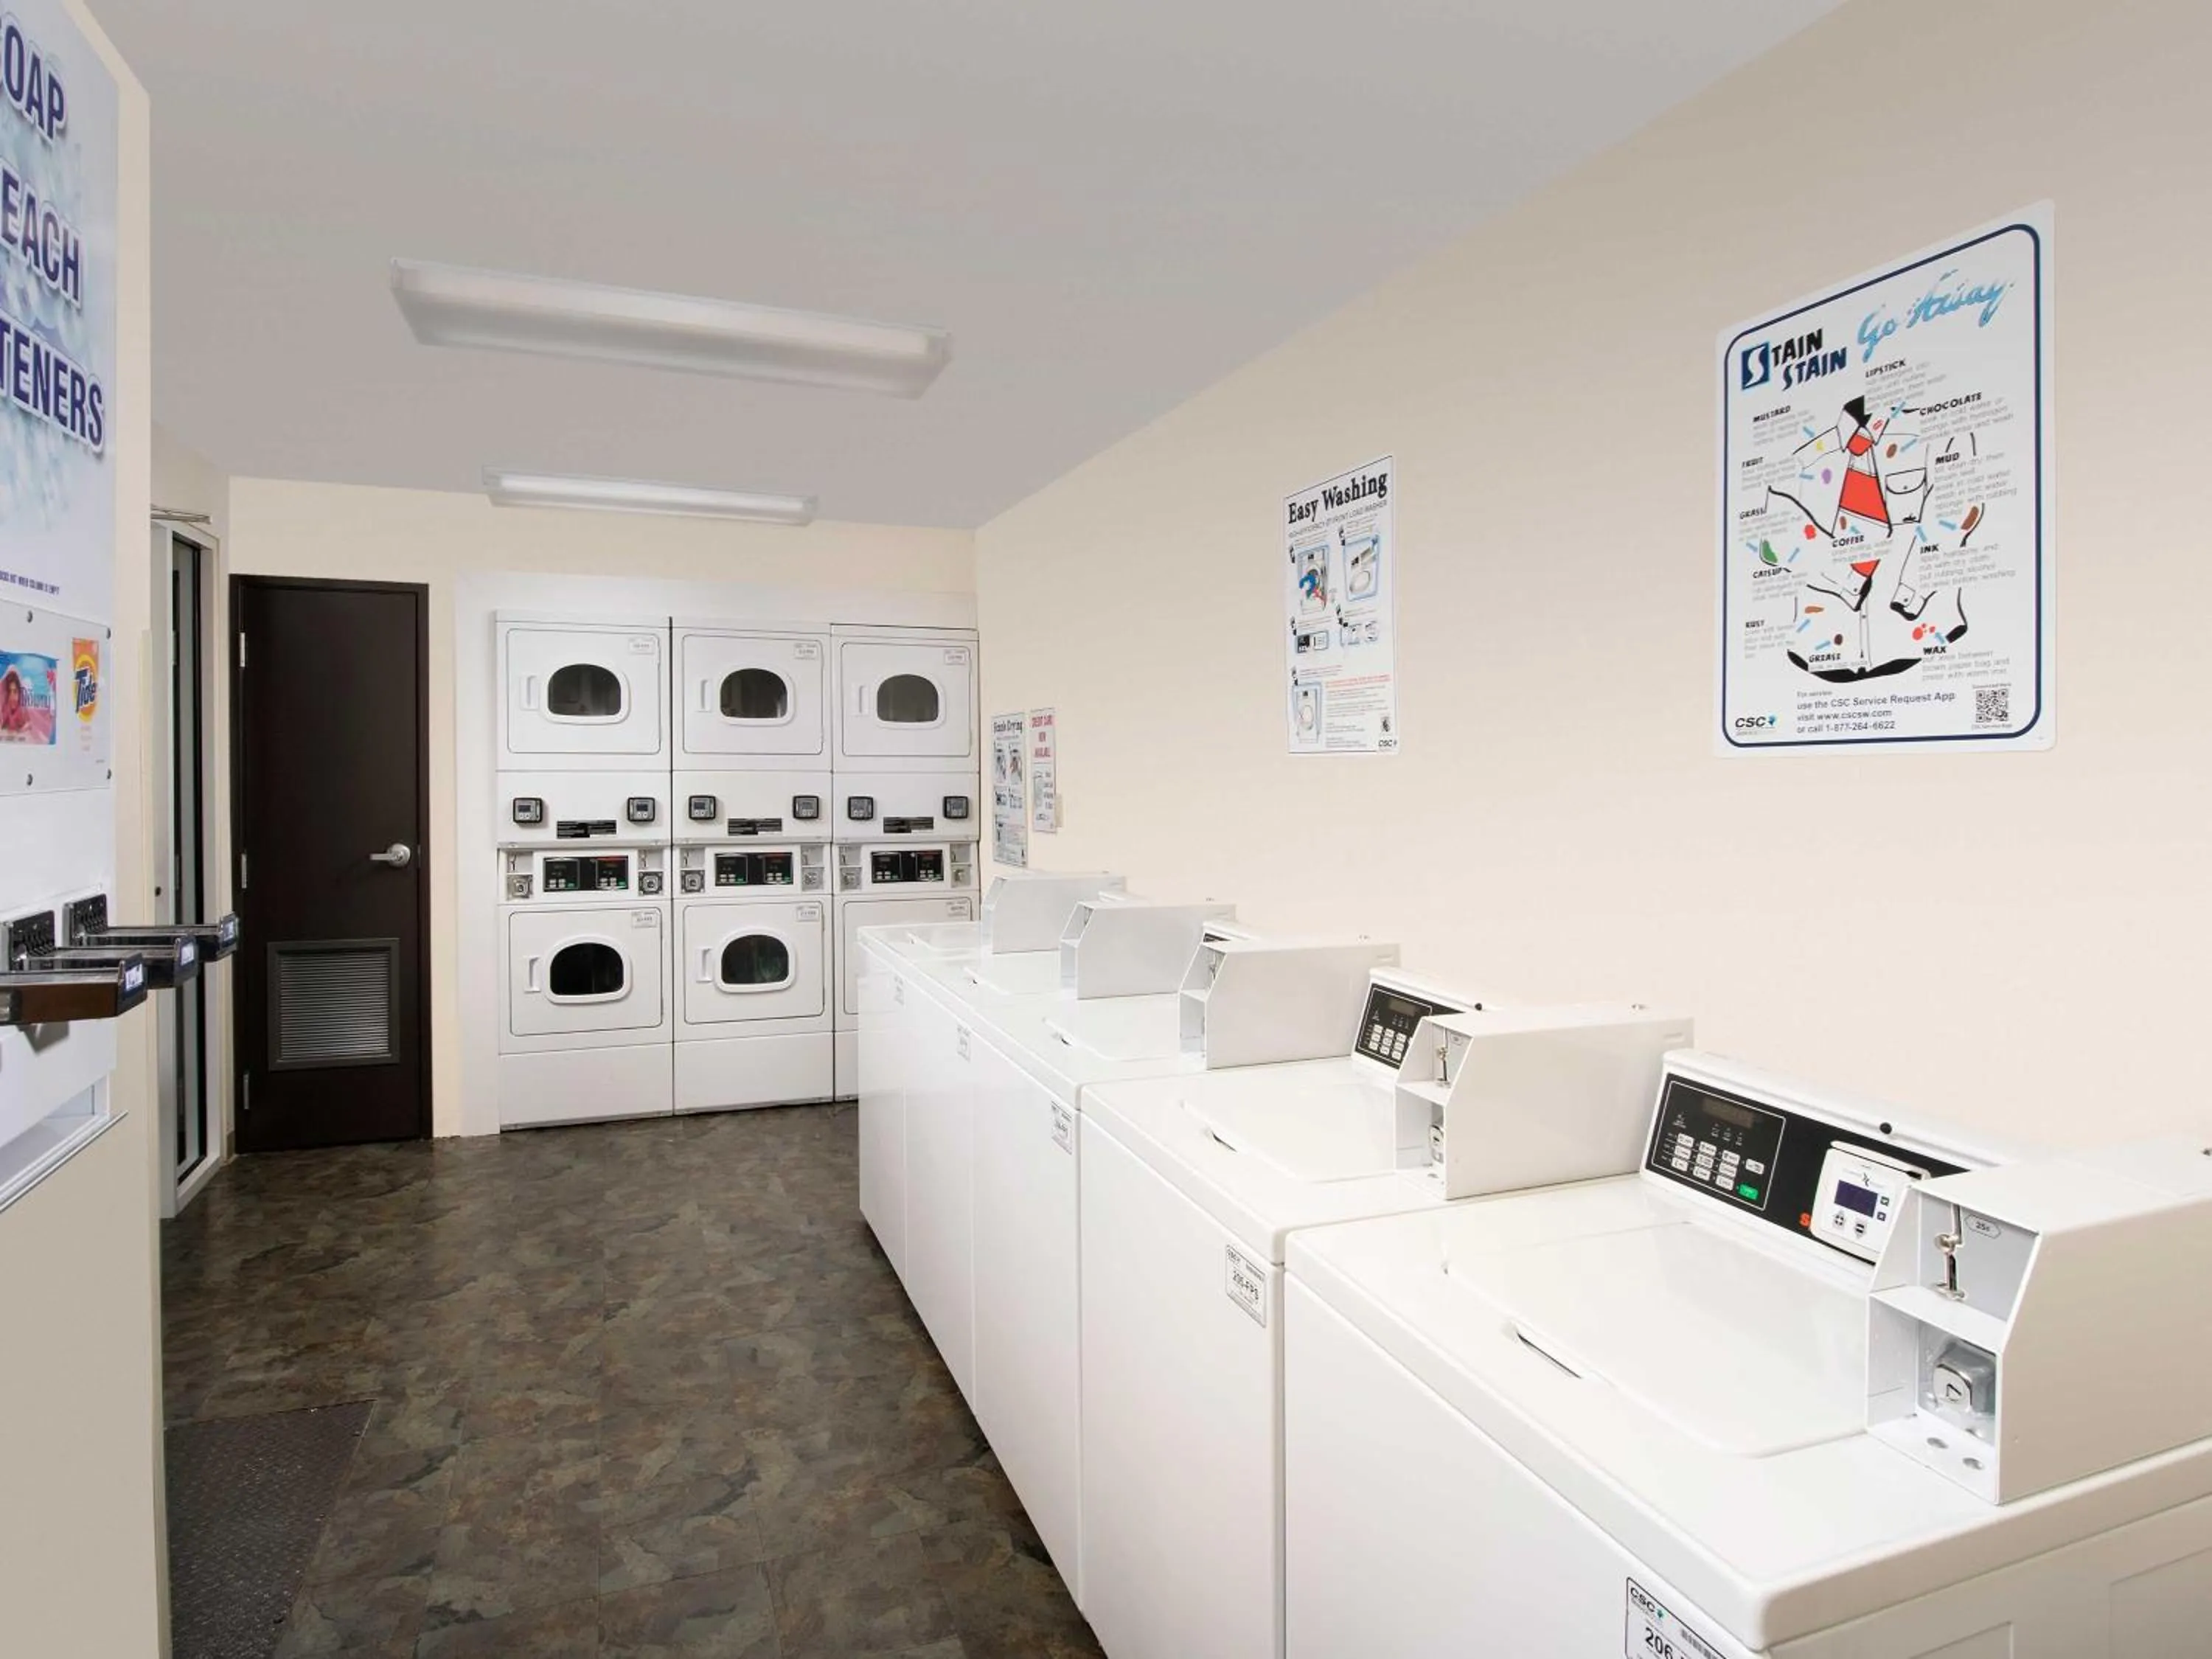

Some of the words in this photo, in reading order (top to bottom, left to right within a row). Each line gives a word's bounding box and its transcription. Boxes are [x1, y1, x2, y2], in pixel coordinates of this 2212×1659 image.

[0, 21, 65, 139] OAP
[1781, 346, 1847, 392] STAIN
[1865, 359, 1906, 378] LIPSTICK
[1919, 392, 1983, 416] CHOCOLATE
[1753, 405, 1792, 422] MUSTARD
[1935, 452, 1961, 465] MUD
[1288, 499, 1319, 524] Easy
[1321, 473, 1388, 512] Washing
[1832, 532, 1865, 548] COFFEE
[1919, 543, 1940, 554] INK
[1752, 566, 1783, 579] CATSUP
[1922, 645, 1947, 655] WAX
[1808, 653, 1842, 664] GREASE
[74, 668, 98, 714] Tide
[1797, 700, 1814, 710] use
[1814, 698, 1829, 709] the
[1830, 698, 1851, 708] CSC
[1852, 695, 1888, 706] Service
[1889, 693, 1932, 706] Request
[1933, 691, 1957, 703] App
[1735, 716, 1767, 728] CSC
[1797, 712, 1815, 722] visit
[1816, 709, 1893, 721] www.cscsw.com
[1796, 726, 1806, 734] or
[1807, 723, 1824, 733] call
[1825, 720, 1896, 732] 1-877-264-6622
[1630, 1586, 1656, 1613] CSC
